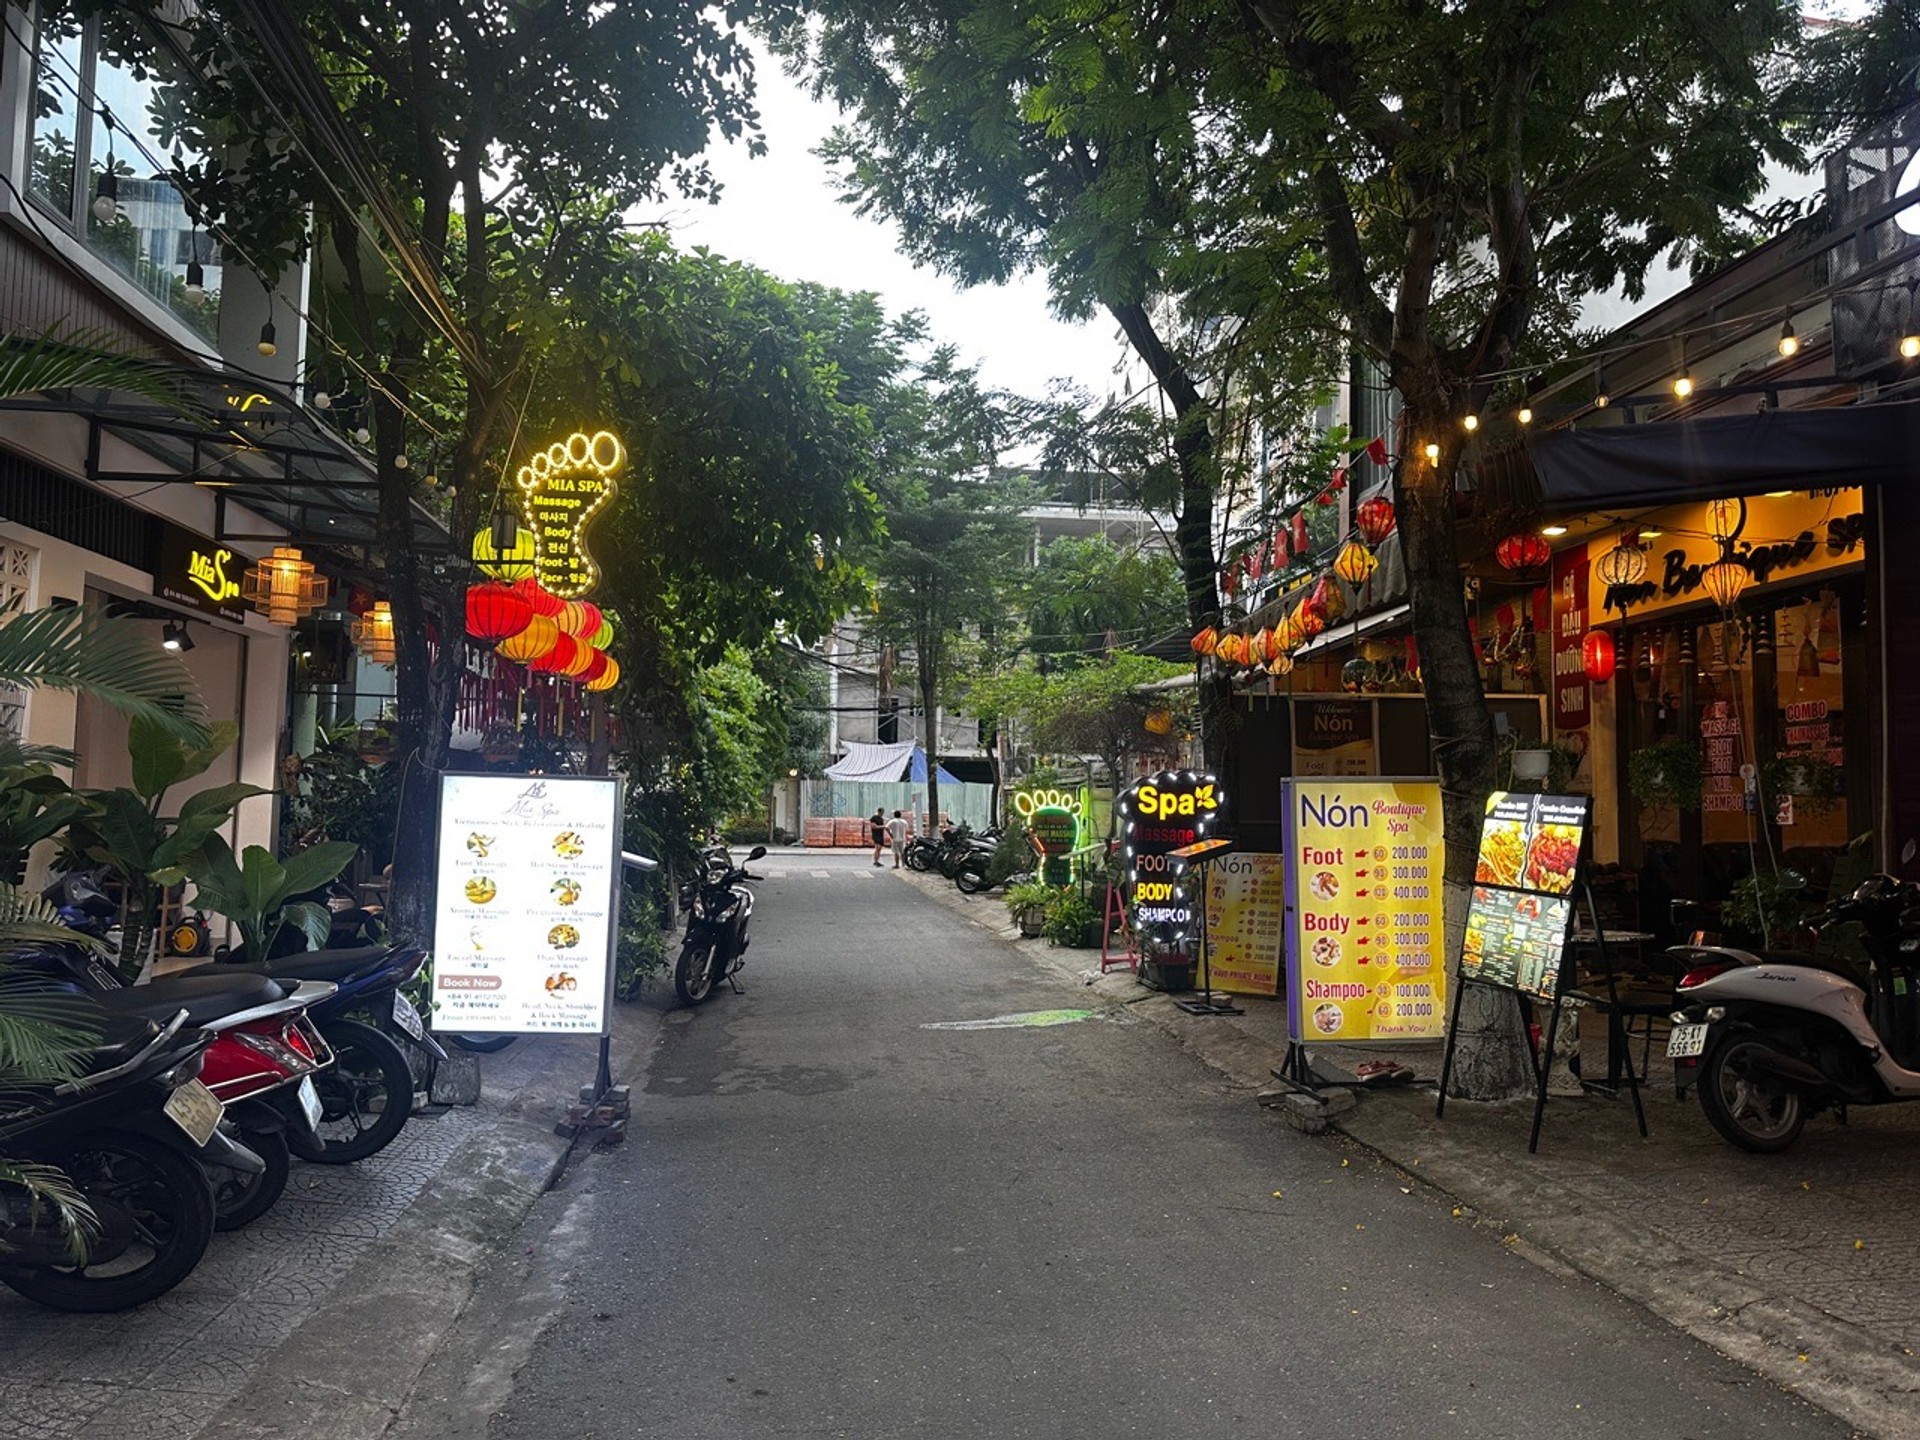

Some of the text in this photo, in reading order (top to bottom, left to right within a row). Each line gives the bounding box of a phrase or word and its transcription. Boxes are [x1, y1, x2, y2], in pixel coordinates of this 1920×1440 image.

[547, 479, 603, 492] MIA SPA
[533, 495, 581, 509] Massage
[545, 526, 572, 540] Body
[188, 551, 215, 583] Mia
[539, 556, 563, 567] Foot
[541, 572, 563, 582] Face
[1561, 686, 1584, 714] SINH
[1786, 701, 1826, 721] COMBO
[1314, 715, 1353, 732] Nón
[1701, 719, 1740, 737] MASSAGE
[1711, 756, 1733, 773] FOOT
[1713, 776, 1733, 791] NAIL
[1138, 785, 1195, 820] Spa
[1301, 793, 1425, 828] Nón Boutique
[1703, 794, 1744, 812] SHAMPOO
[1387, 818, 1409, 837] Spa
[1133, 828, 1195, 845] Massage
[1302, 847, 1344, 865] Foot
[1391, 846, 1428, 859] 200.000
[1213, 857, 1252, 874] Nón
[1392, 866, 1428, 878] 300.000
[1137, 883, 1173, 901] BODY
[1393, 886, 1429, 898] 400.000
[1304, 913, 1350, 935] Body
[1394, 914, 1429, 926] 200.000
[1207, 934, 1239, 943] hampoo
[1395, 932, 1429, 945] 300.000
[1395, 953, 1431, 966] 400.000
[443, 978, 498, 989] Book Now
[1755, 972, 1797, 982] Janus
[1306, 980, 1365, 1001] Shampoo
[1396, 984, 1431, 997] 100.000
[1397, 1003, 1432, 1016] 200.000
[1375, 1024, 1403, 1033] Thank
[1409, 1024, 1425, 1033] You
